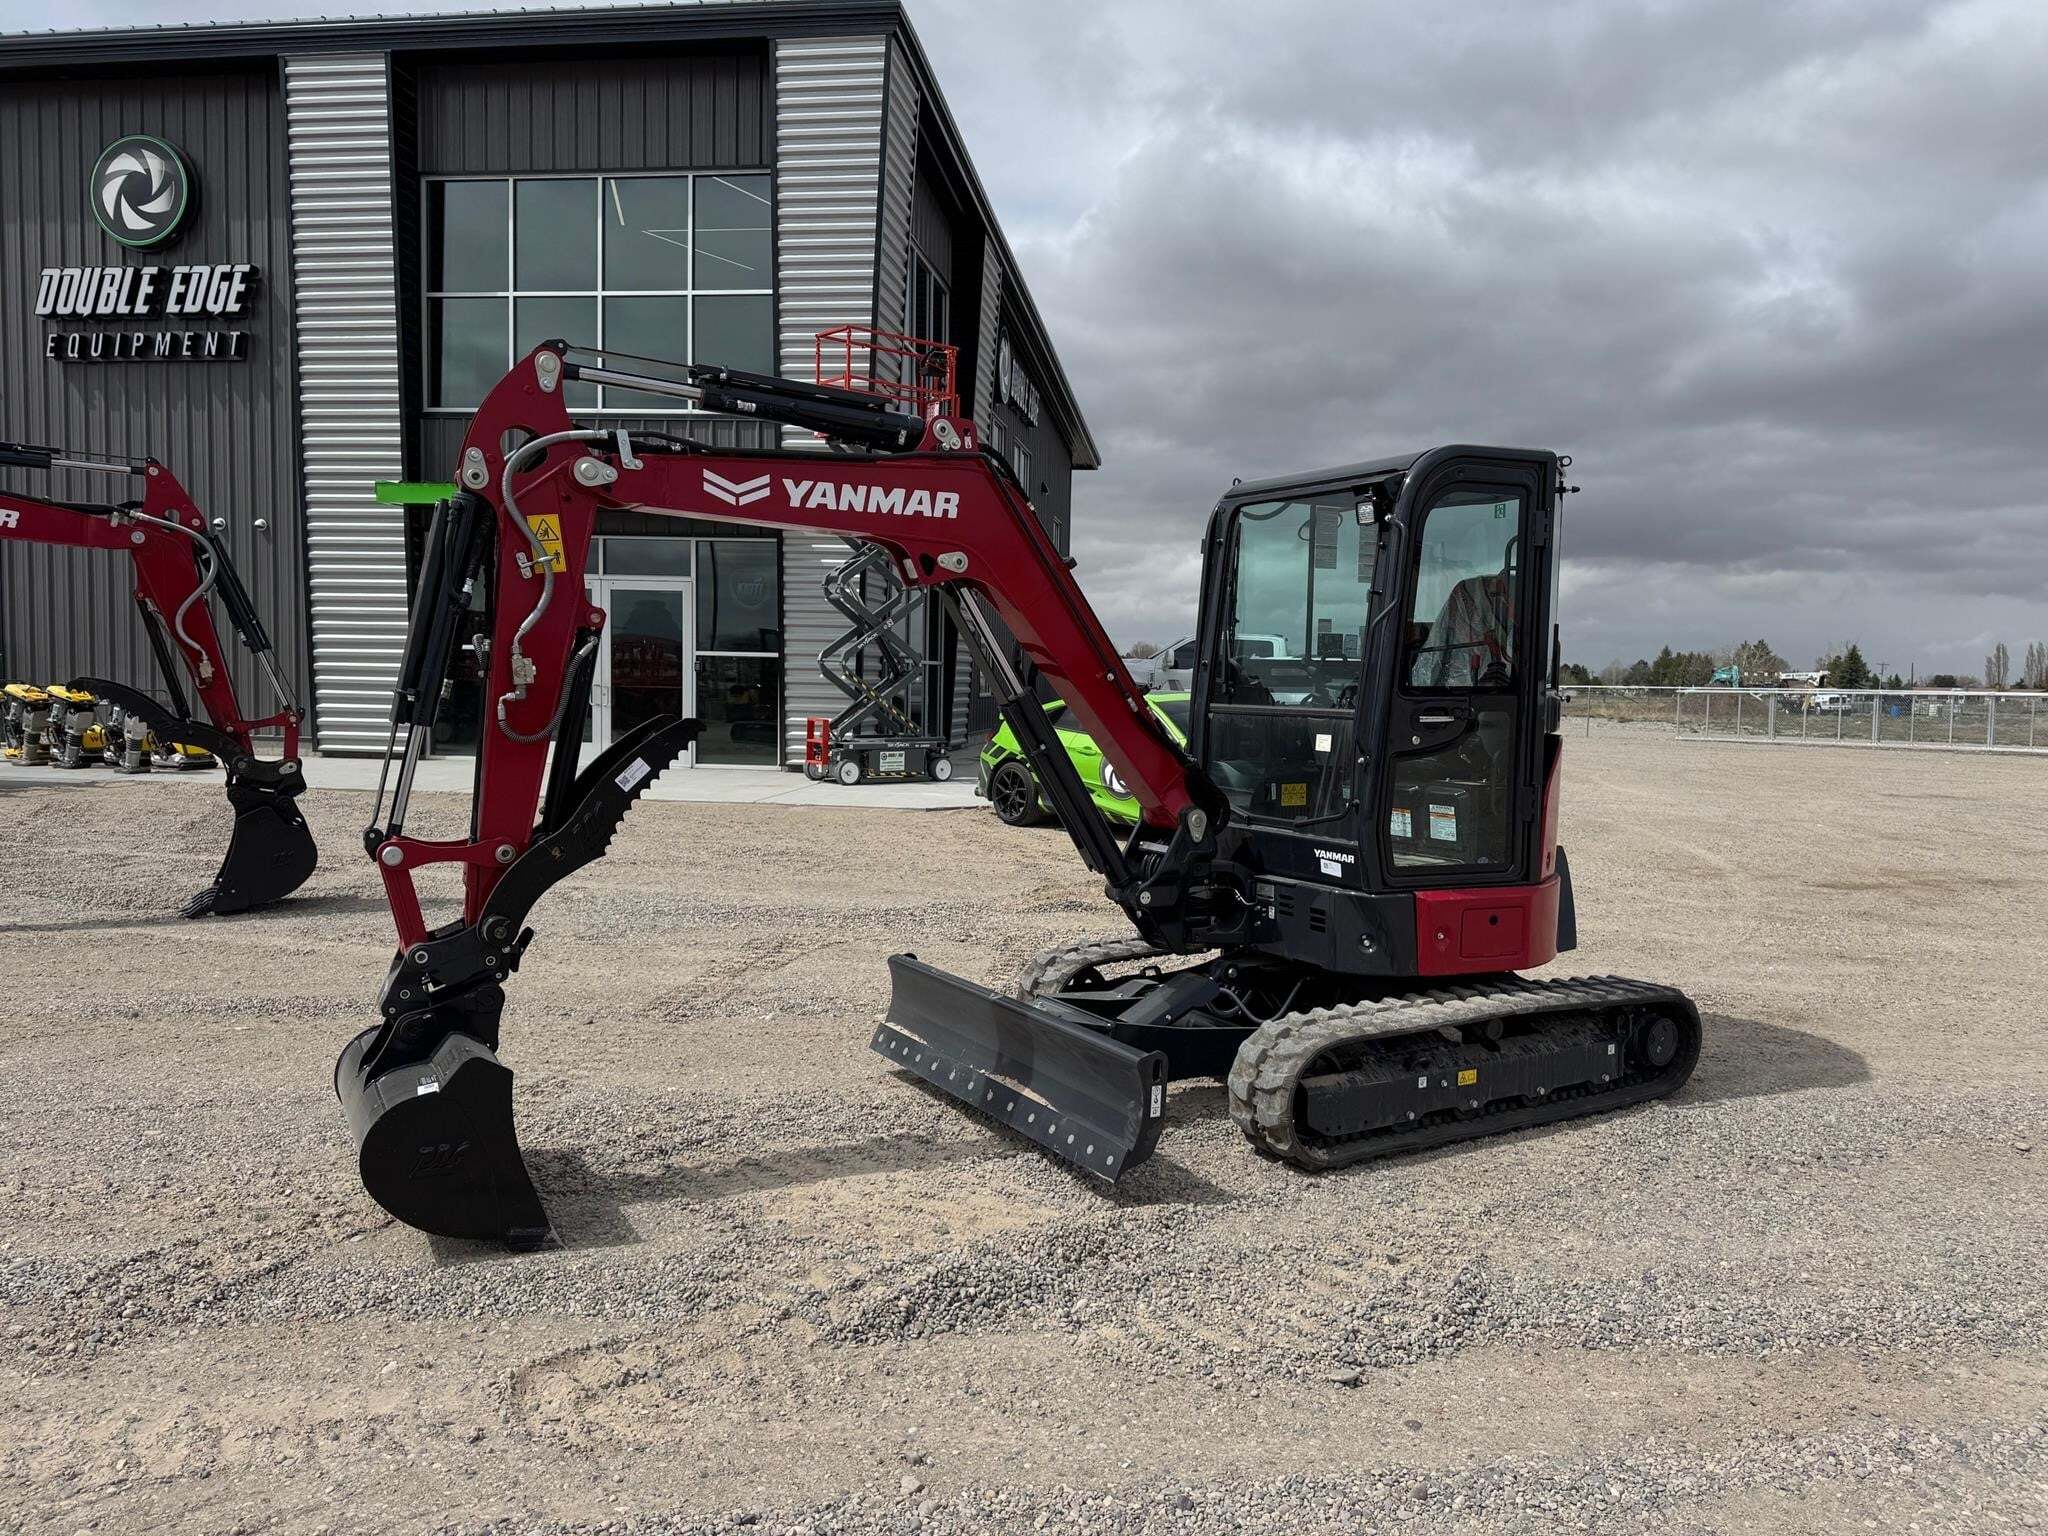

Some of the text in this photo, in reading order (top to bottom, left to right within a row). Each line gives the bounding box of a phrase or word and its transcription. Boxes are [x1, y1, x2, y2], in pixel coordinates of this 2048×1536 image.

[35, 264, 251, 318] DOUBLE EDGE
[46, 331, 241, 357] EQUIPMENT
[782, 478, 960, 519] YANMAR
[1313, 848, 1355, 864] YANMAR
